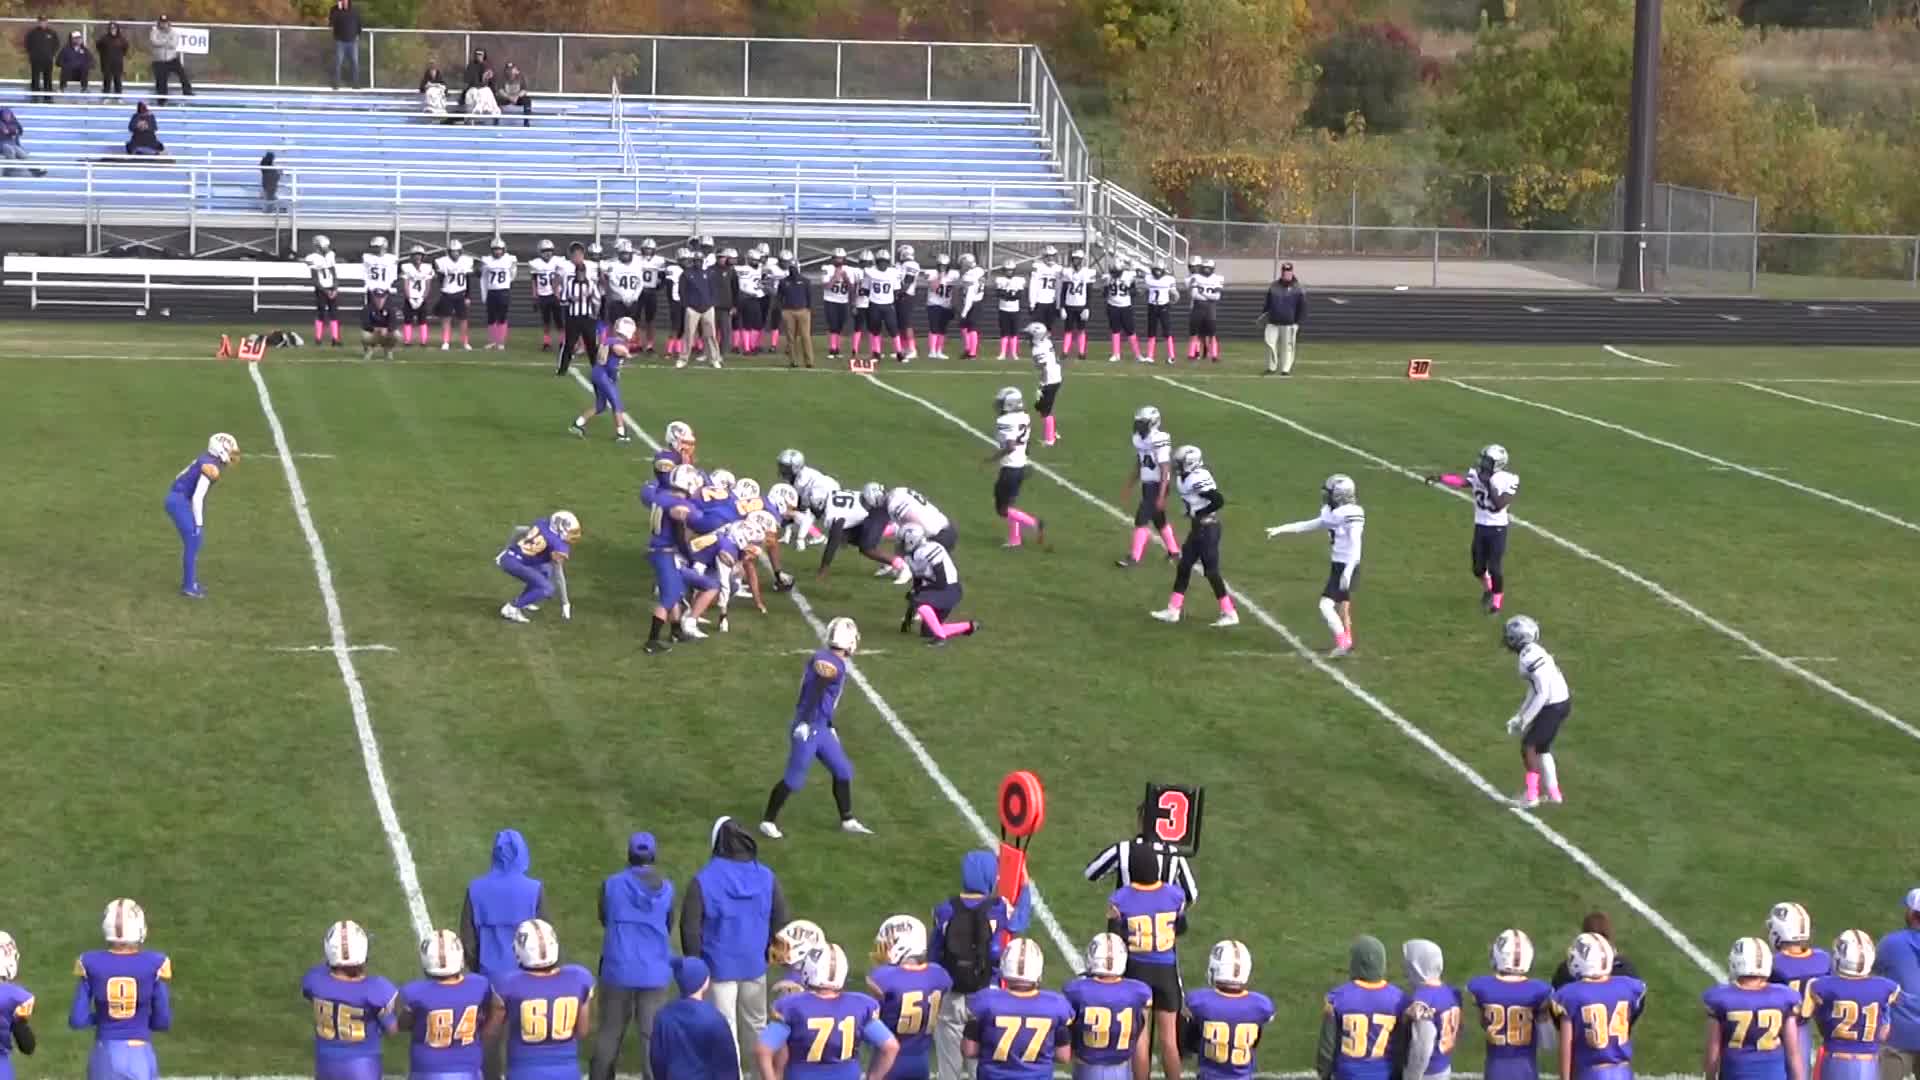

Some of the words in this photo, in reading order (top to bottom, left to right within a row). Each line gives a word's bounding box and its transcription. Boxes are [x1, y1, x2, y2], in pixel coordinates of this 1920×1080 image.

[370, 266, 386, 281] 51
[489, 271, 506, 284] 78
[242, 340, 262, 355] 50
[1411, 361, 1430, 375] 30
[1156, 790, 1189, 841] 3
[106, 976, 138, 1019] 9
[520, 996, 579, 1043] 60
[897, 990, 942, 1035] 51
[806, 1015, 856, 1062] 71
[993, 1015, 1053, 1062] 77
[1083, 1006, 1134, 1050] 31
[1341, 1012, 1396, 1058] 37
[1581, 1000, 1630, 1049] 34
[1727, 1008, 1783, 1050] 72
[1831, 1000, 1879, 1042] 21
